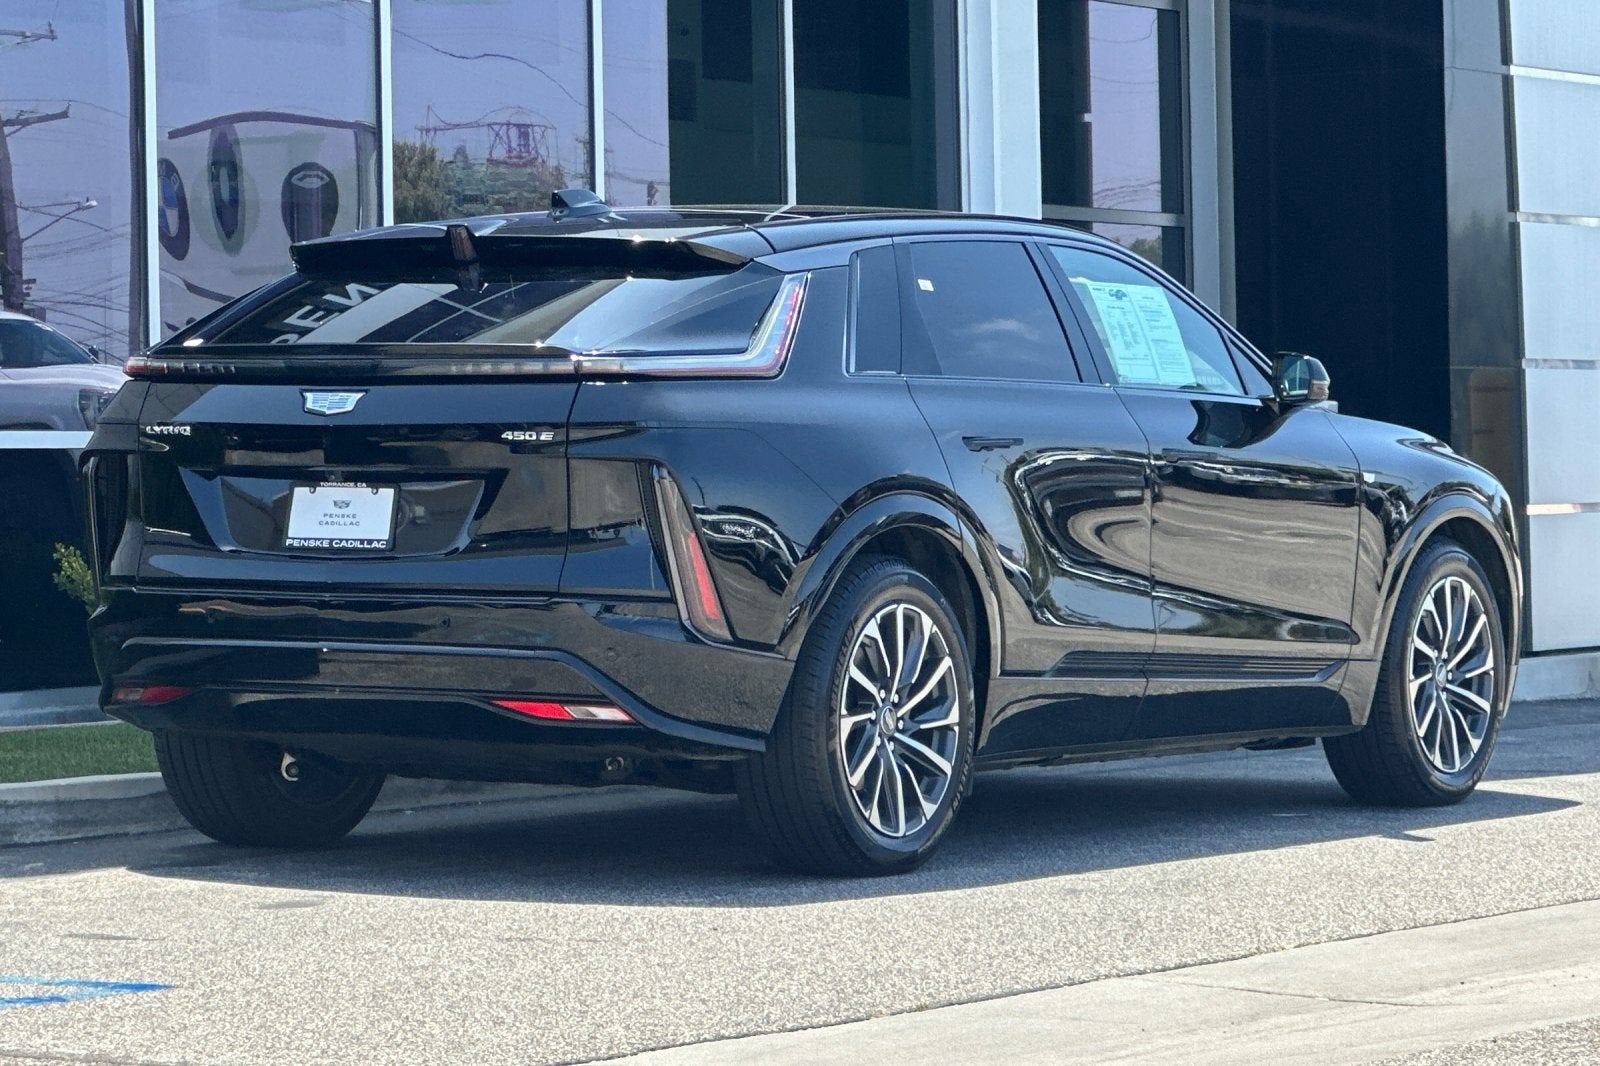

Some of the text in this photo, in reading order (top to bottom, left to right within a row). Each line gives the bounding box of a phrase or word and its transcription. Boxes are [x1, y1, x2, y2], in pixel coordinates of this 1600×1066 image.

[501, 431, 555, 441] 450 E
[285, 539, 387, 549] PENSKE CADILLAC
